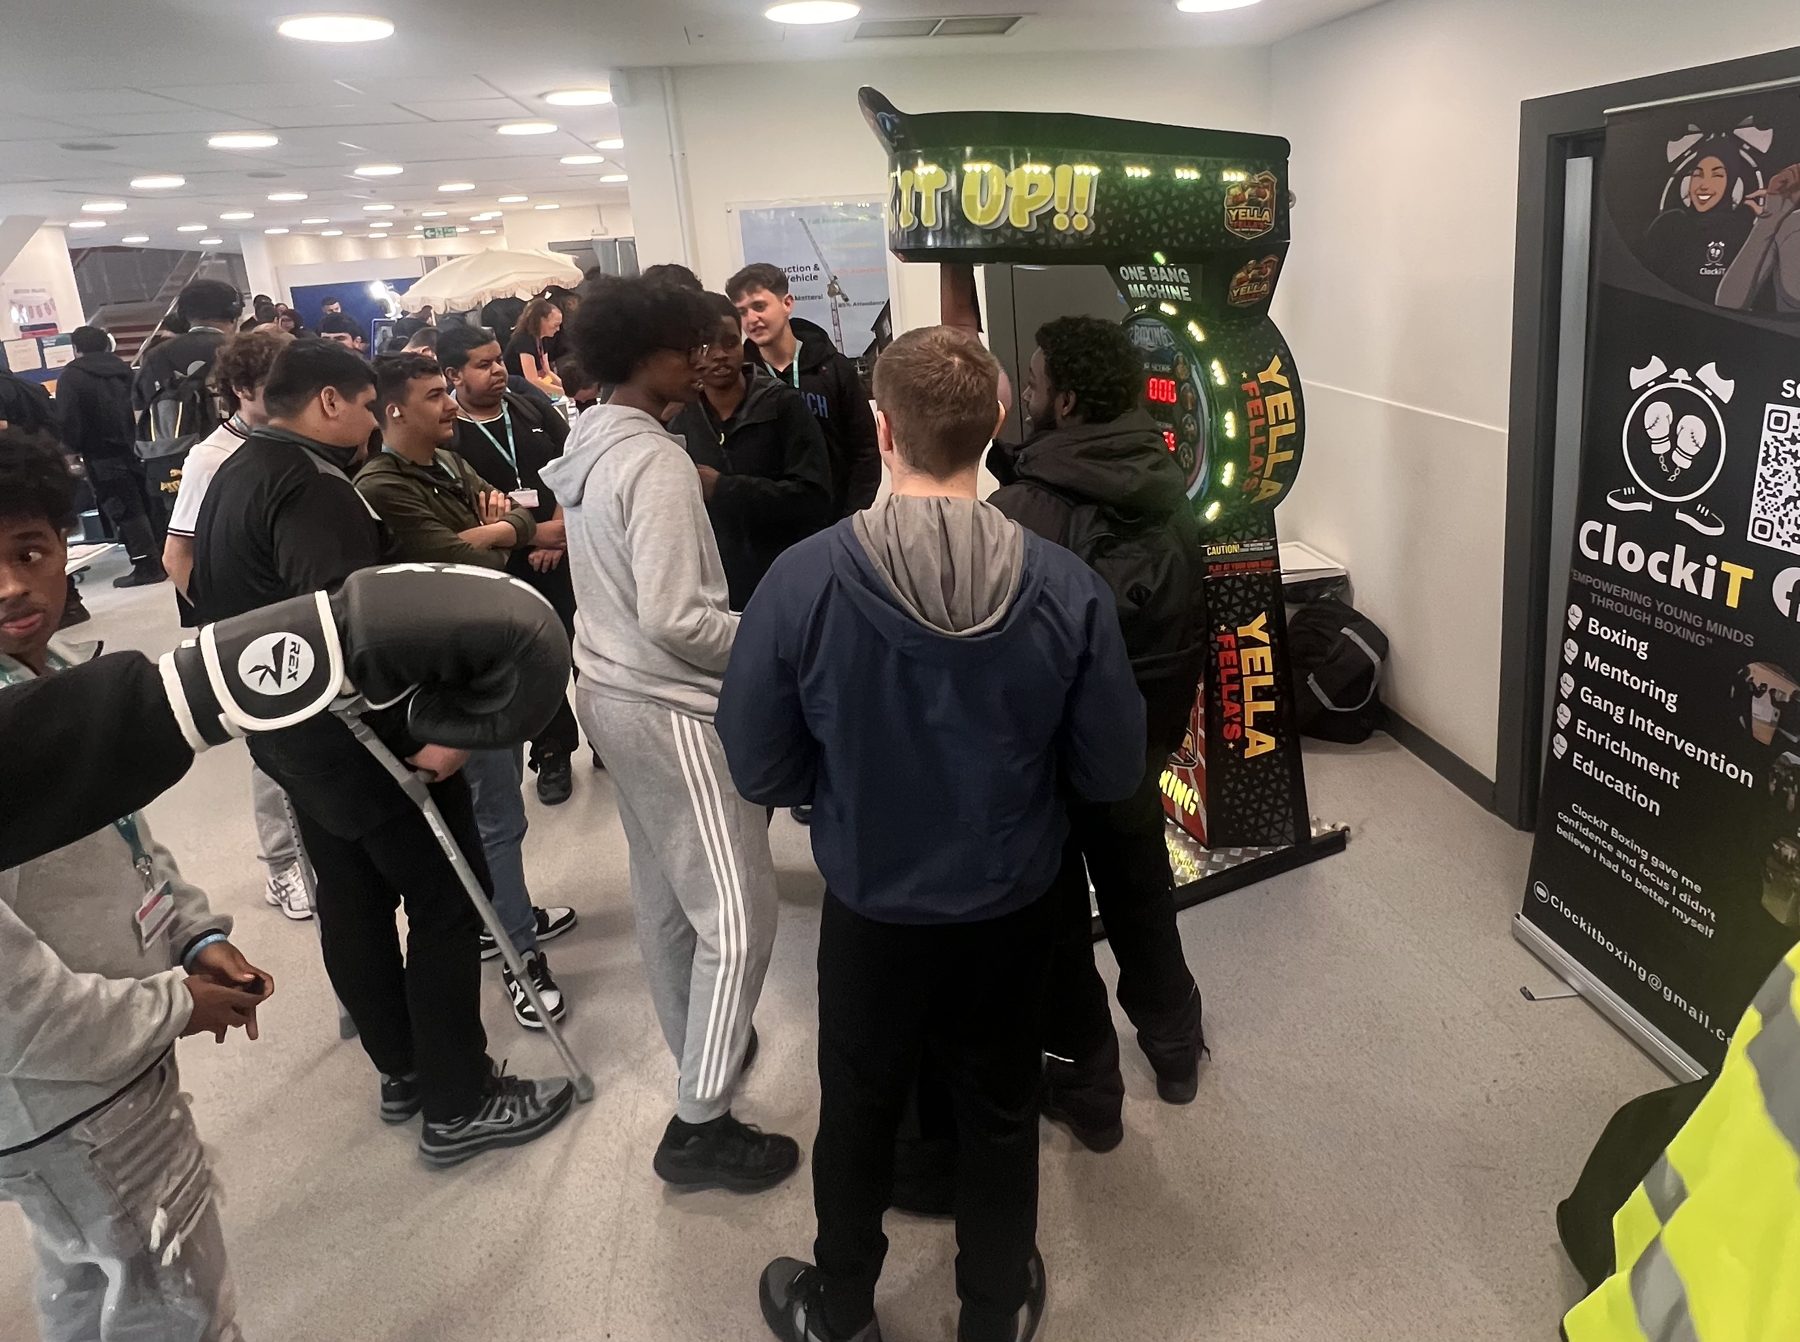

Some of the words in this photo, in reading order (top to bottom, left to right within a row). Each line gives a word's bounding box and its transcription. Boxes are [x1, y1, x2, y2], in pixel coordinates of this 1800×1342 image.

[962, 164, 1098, 234] UP!!
[1228, 208, 1272, 222] YELLA
[1120, 266, 1148, 281] ONE
[1148, 266, 1191, 284] BANG
[1128, 284, 1192, 301] MACHINE
[1232, 283, 1268, 297] YELLA
[1251, 355, 1296, 503] YELLA
[1207, 544, 1240, 556] CAUTION!
[1578, 520, 1754, 609] ClockiT
[1587, 617, 1649, 660] Boxing
[1590, 592, 1651, 625] THROUGH
[1655, 600, 1703, 626] YOUNG
[1706, 619, 1755, 647] MINDS
[287, 641, 301, 681] REX
[1216, 634, 1242, 741] FELLA'S
[1237, 611, 1276, 759] YELLA
[1583, 651, 1679, 713] Mentoring
[1576, 719, 1680, 790] Enrichment
[1580, 686, 1625, 724] Gang
[1629, 708, 1755, 788] Intervention
[1572, 751, 1661, 817] Education
[1556, 824, 1591, 855] believe
[1599, 852, 1619, 874] had
[1621, 867, 1633, 882] to
[1634, 876, 1670, 908] better
[1671, 906, 1716, 940] myself
[1557, 811, 1614, 852] confidence
[1616, 849, 1637, 869] and
[1638, 862, 1670, 890] focus
[1678, 888, 1717, 922] didn't
[1571, 803, 1609, 832] ClockiT
[1610, 827, 1649, 860] Boxing
[1650, 855, 1679, 879] gave
[1681, 875, 1702, 894] me
[1550, 895, 1732, 1046] Clockitboxing@gmail.c
